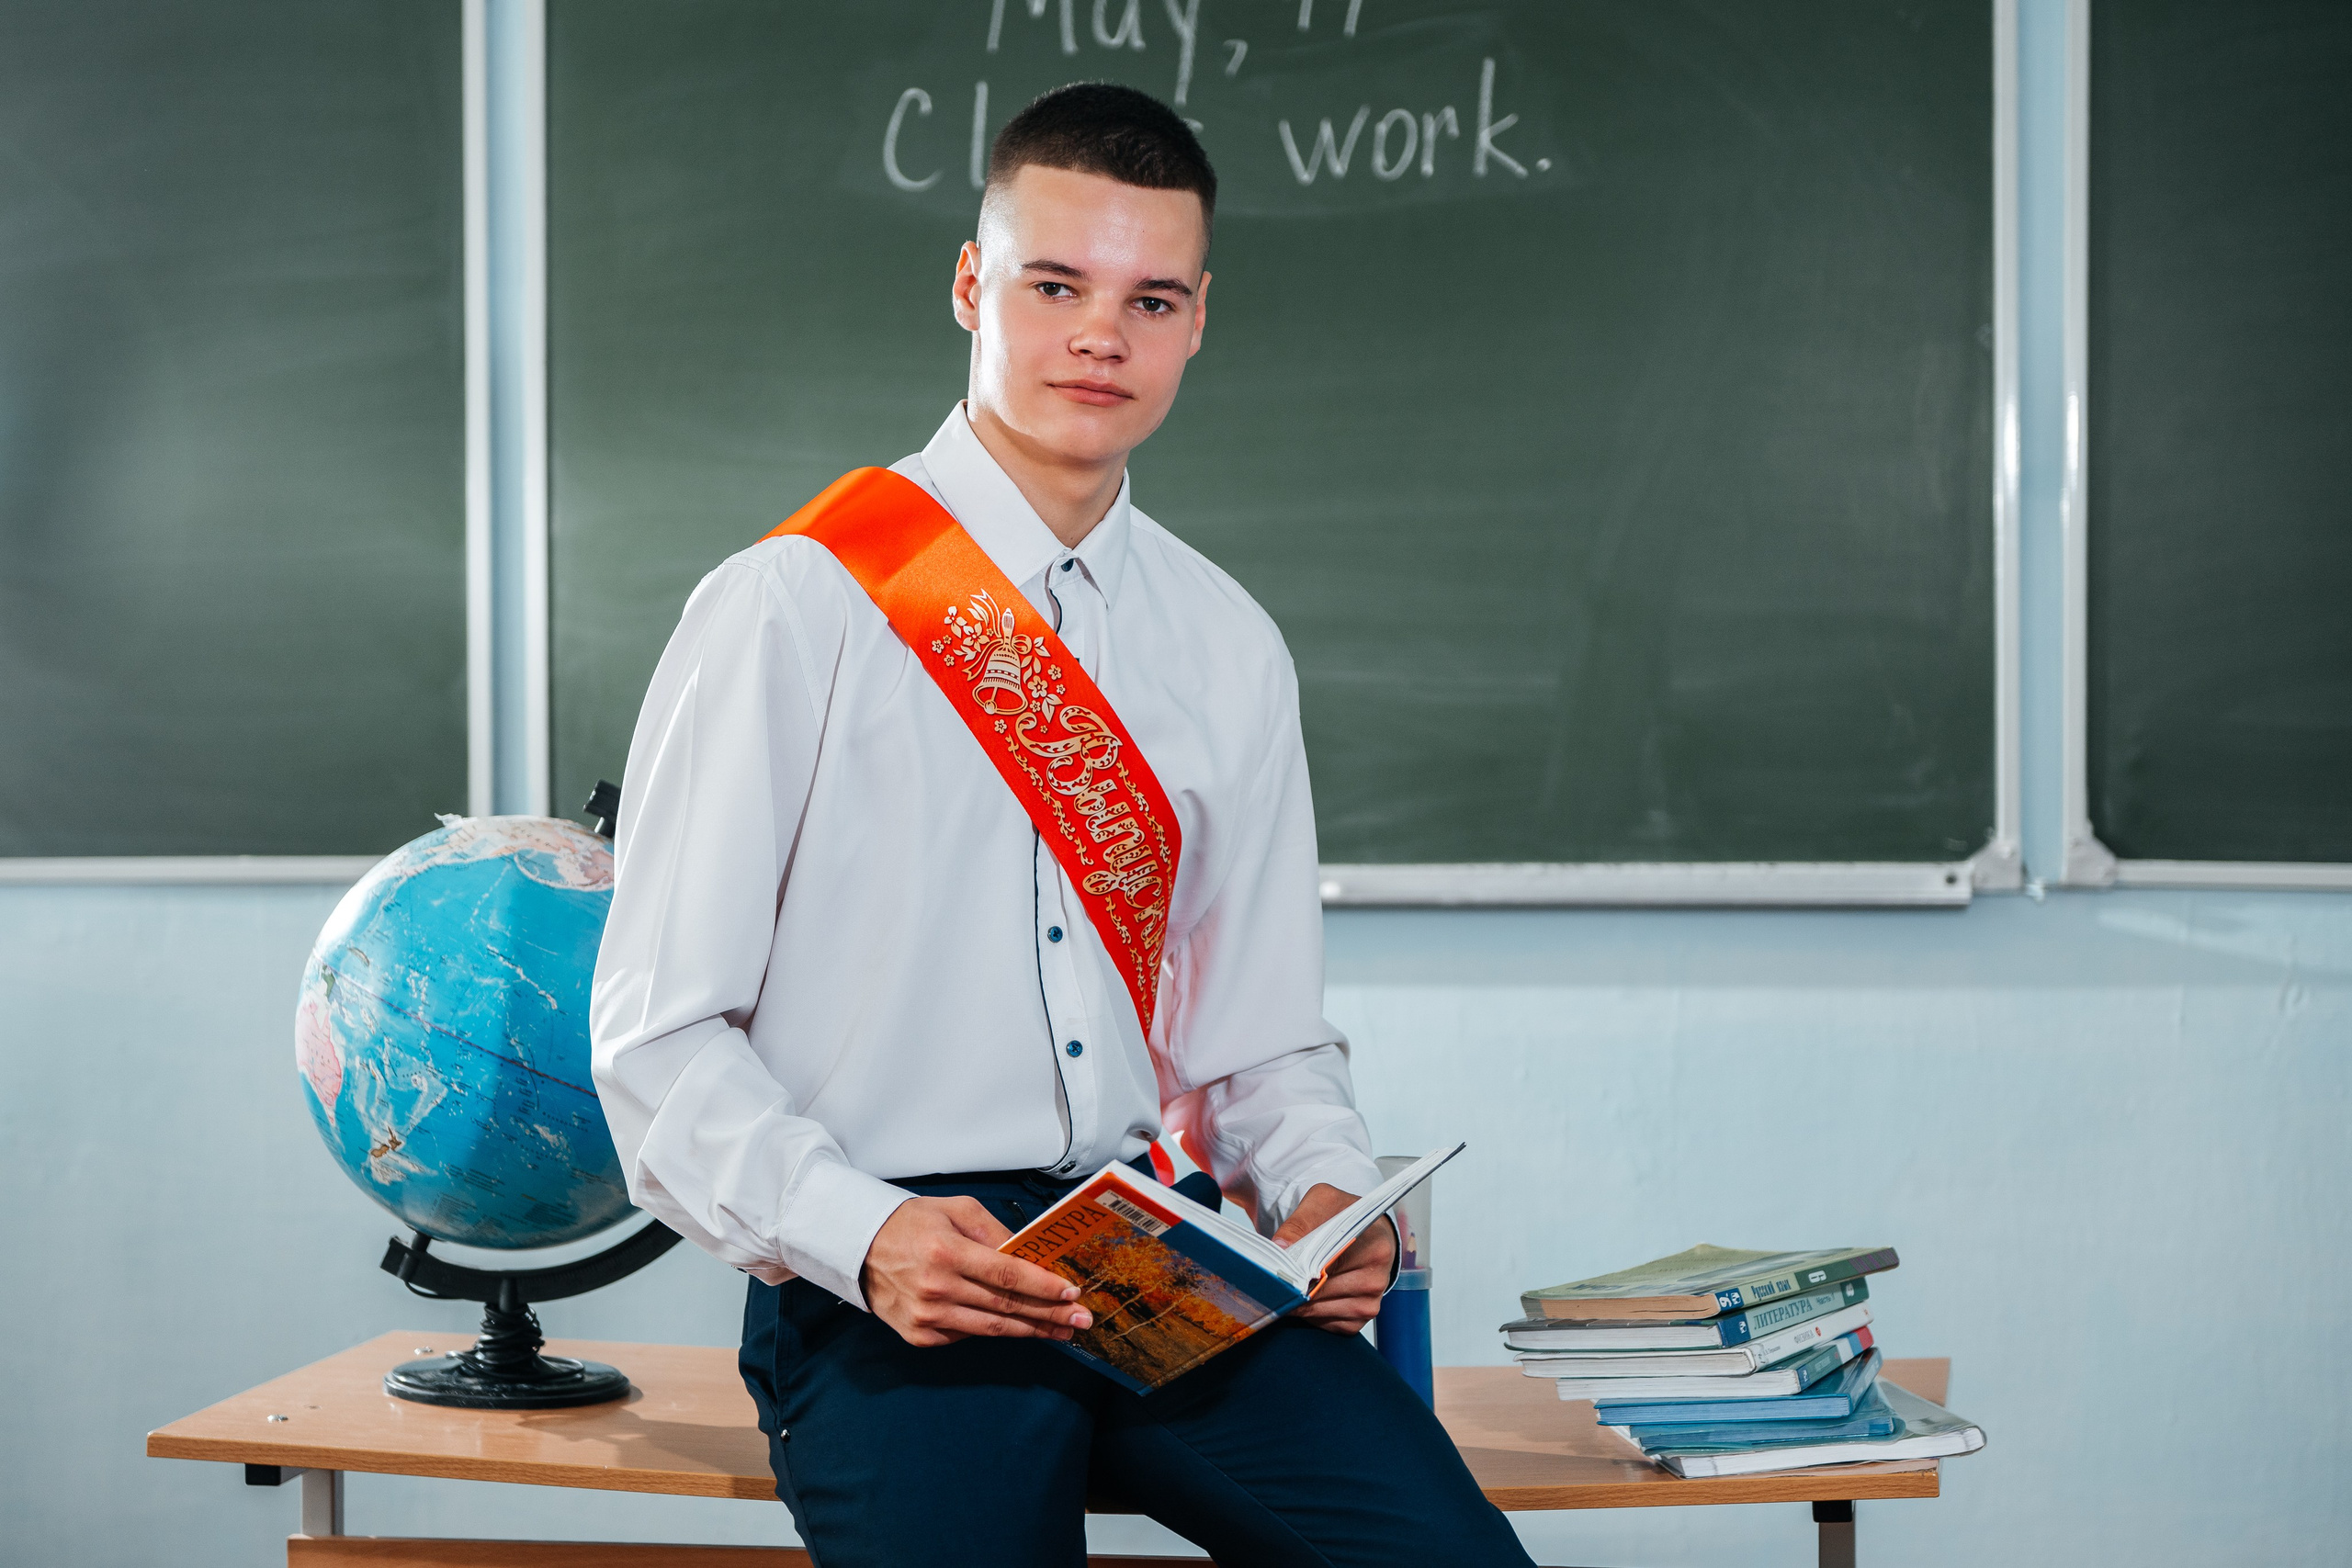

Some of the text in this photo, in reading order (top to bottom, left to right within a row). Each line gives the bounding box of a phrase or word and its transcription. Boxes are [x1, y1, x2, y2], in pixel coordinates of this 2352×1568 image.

[1279, 57, 1553, 184] work.
[1011, 1202, 1108, 1265] ЕРАТУРА
[1754, 1297, 1813, 1330] ЛИТЕРАТУРА
